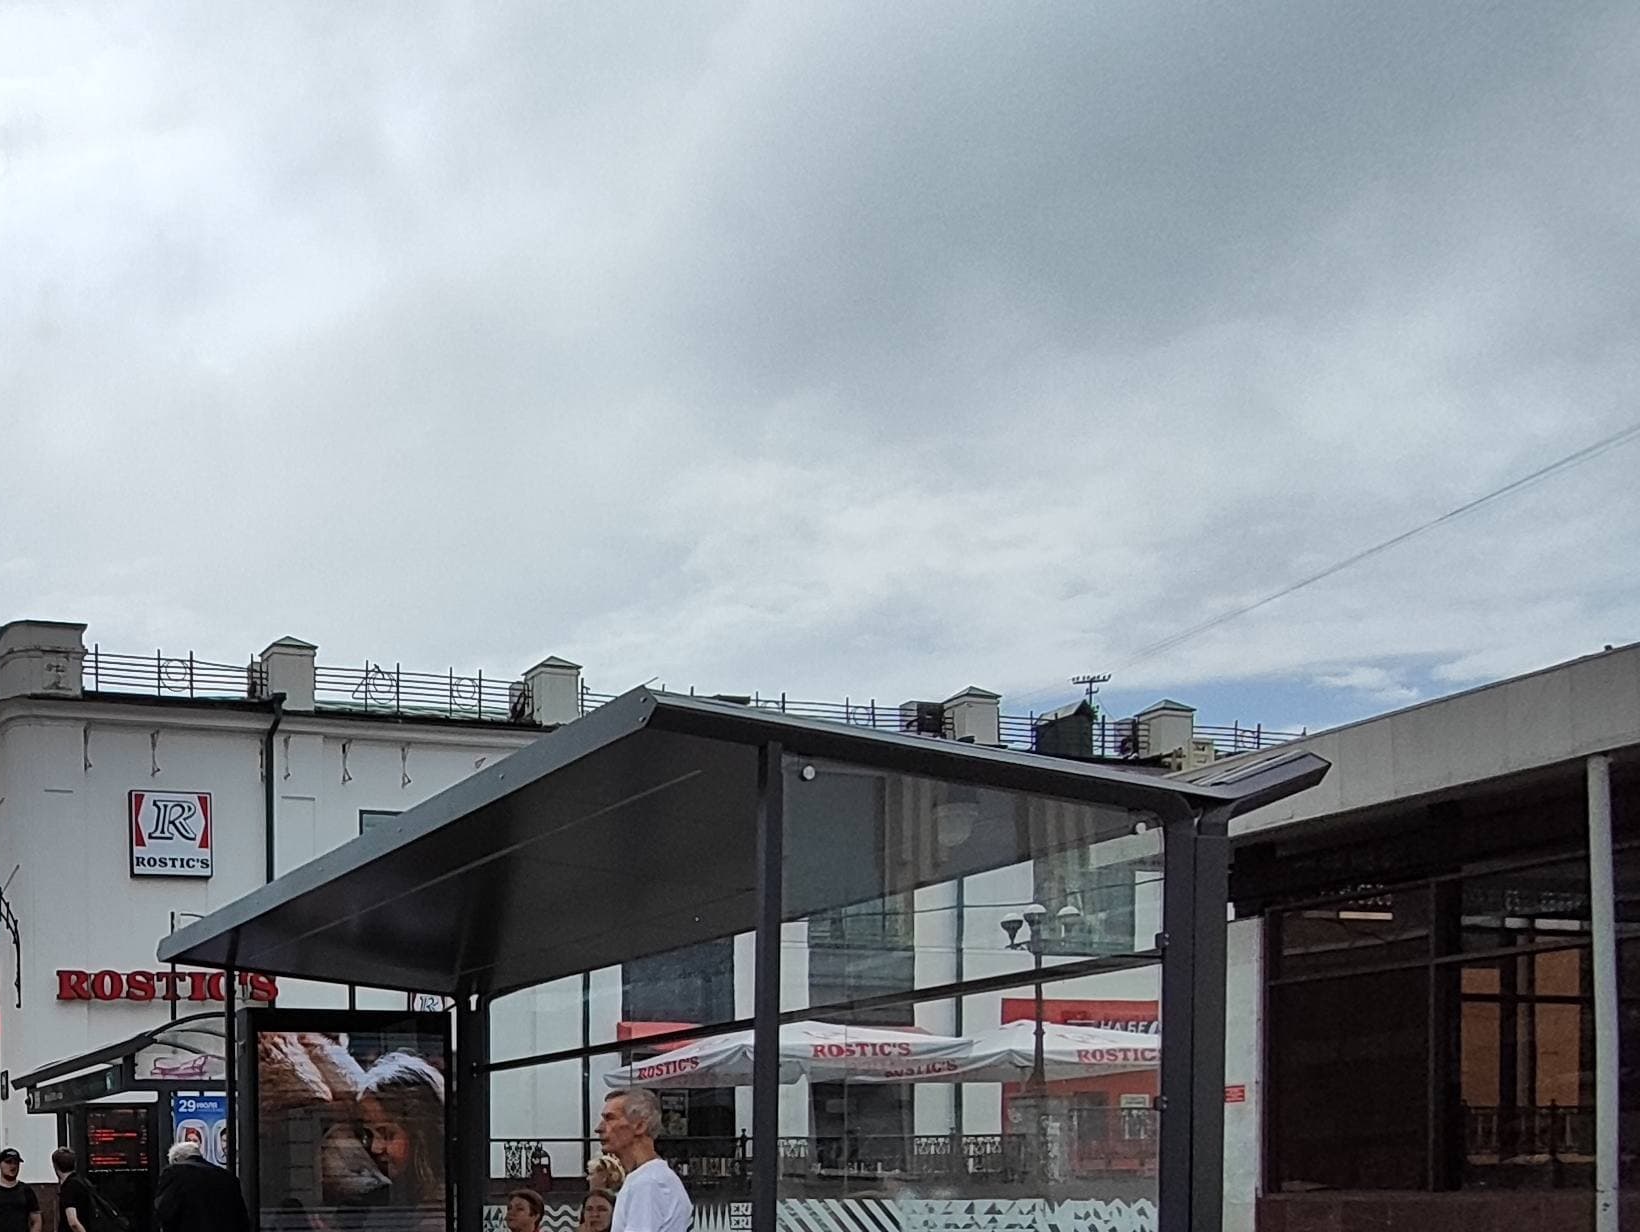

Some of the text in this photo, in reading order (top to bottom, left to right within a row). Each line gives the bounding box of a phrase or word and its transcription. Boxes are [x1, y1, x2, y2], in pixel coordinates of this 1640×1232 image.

[148, 800, 197, 841] R
[135, 856, 210, 869] ROSTIC'S
[812, 1042, 912, 1059] ROSTIC'S
[638, 1055, 700, 1081] ROSTIC'S
[179, 1100, 196, 1112] 29
